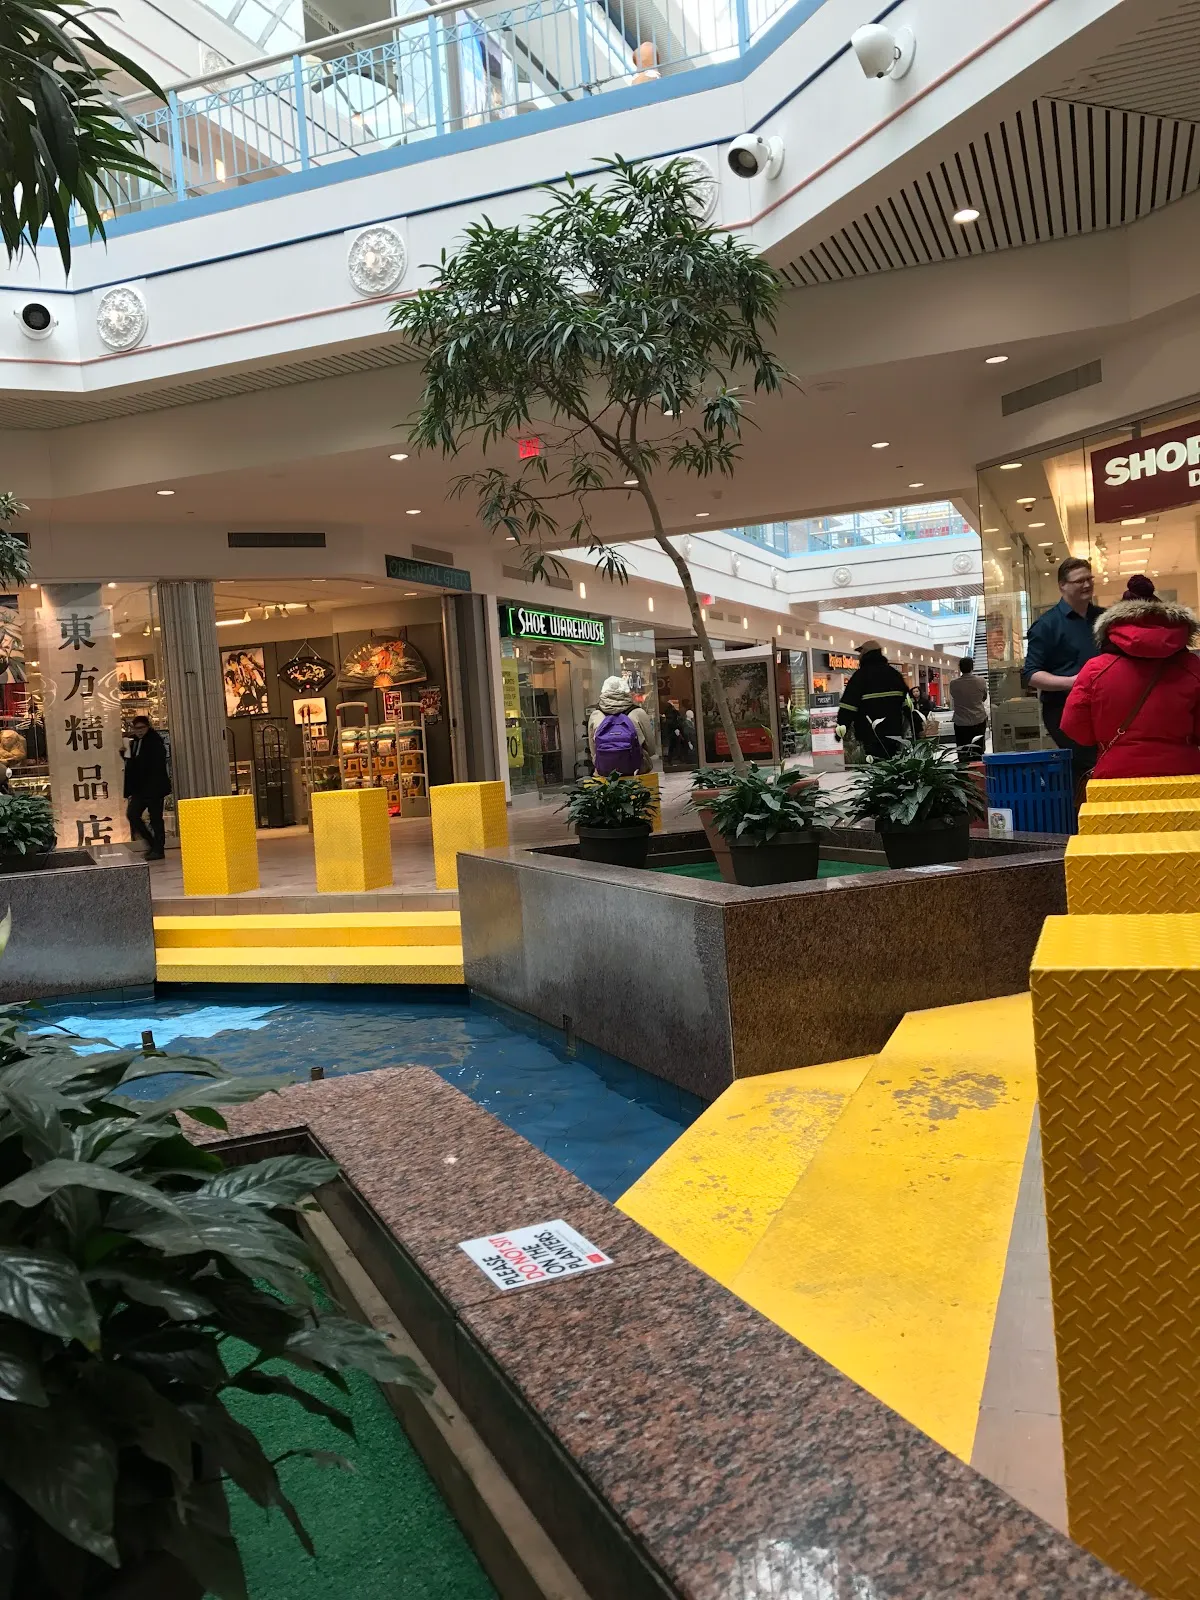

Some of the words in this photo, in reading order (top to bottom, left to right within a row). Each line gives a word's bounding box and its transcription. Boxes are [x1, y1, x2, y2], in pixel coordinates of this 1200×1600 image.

[389, 560, 441, 583] ORIENTAL
[443, 570, 470, 589] GIFTS
[517, 607, 547, 635] SHOE
[549, 615, 605, 641] WAREHOUSE
[56, 613, 114, 847] 東方精品店
[488, 1236, 513, 1249] SIT
[499, 1245, 526, 1266] NOT
[521, 1244, 549, 1263] THE
[537, 1253, 566, 1274] ON
[482, 1254, 525, 1286] PLEASE
[518, 1264, 546, 1281] DO
